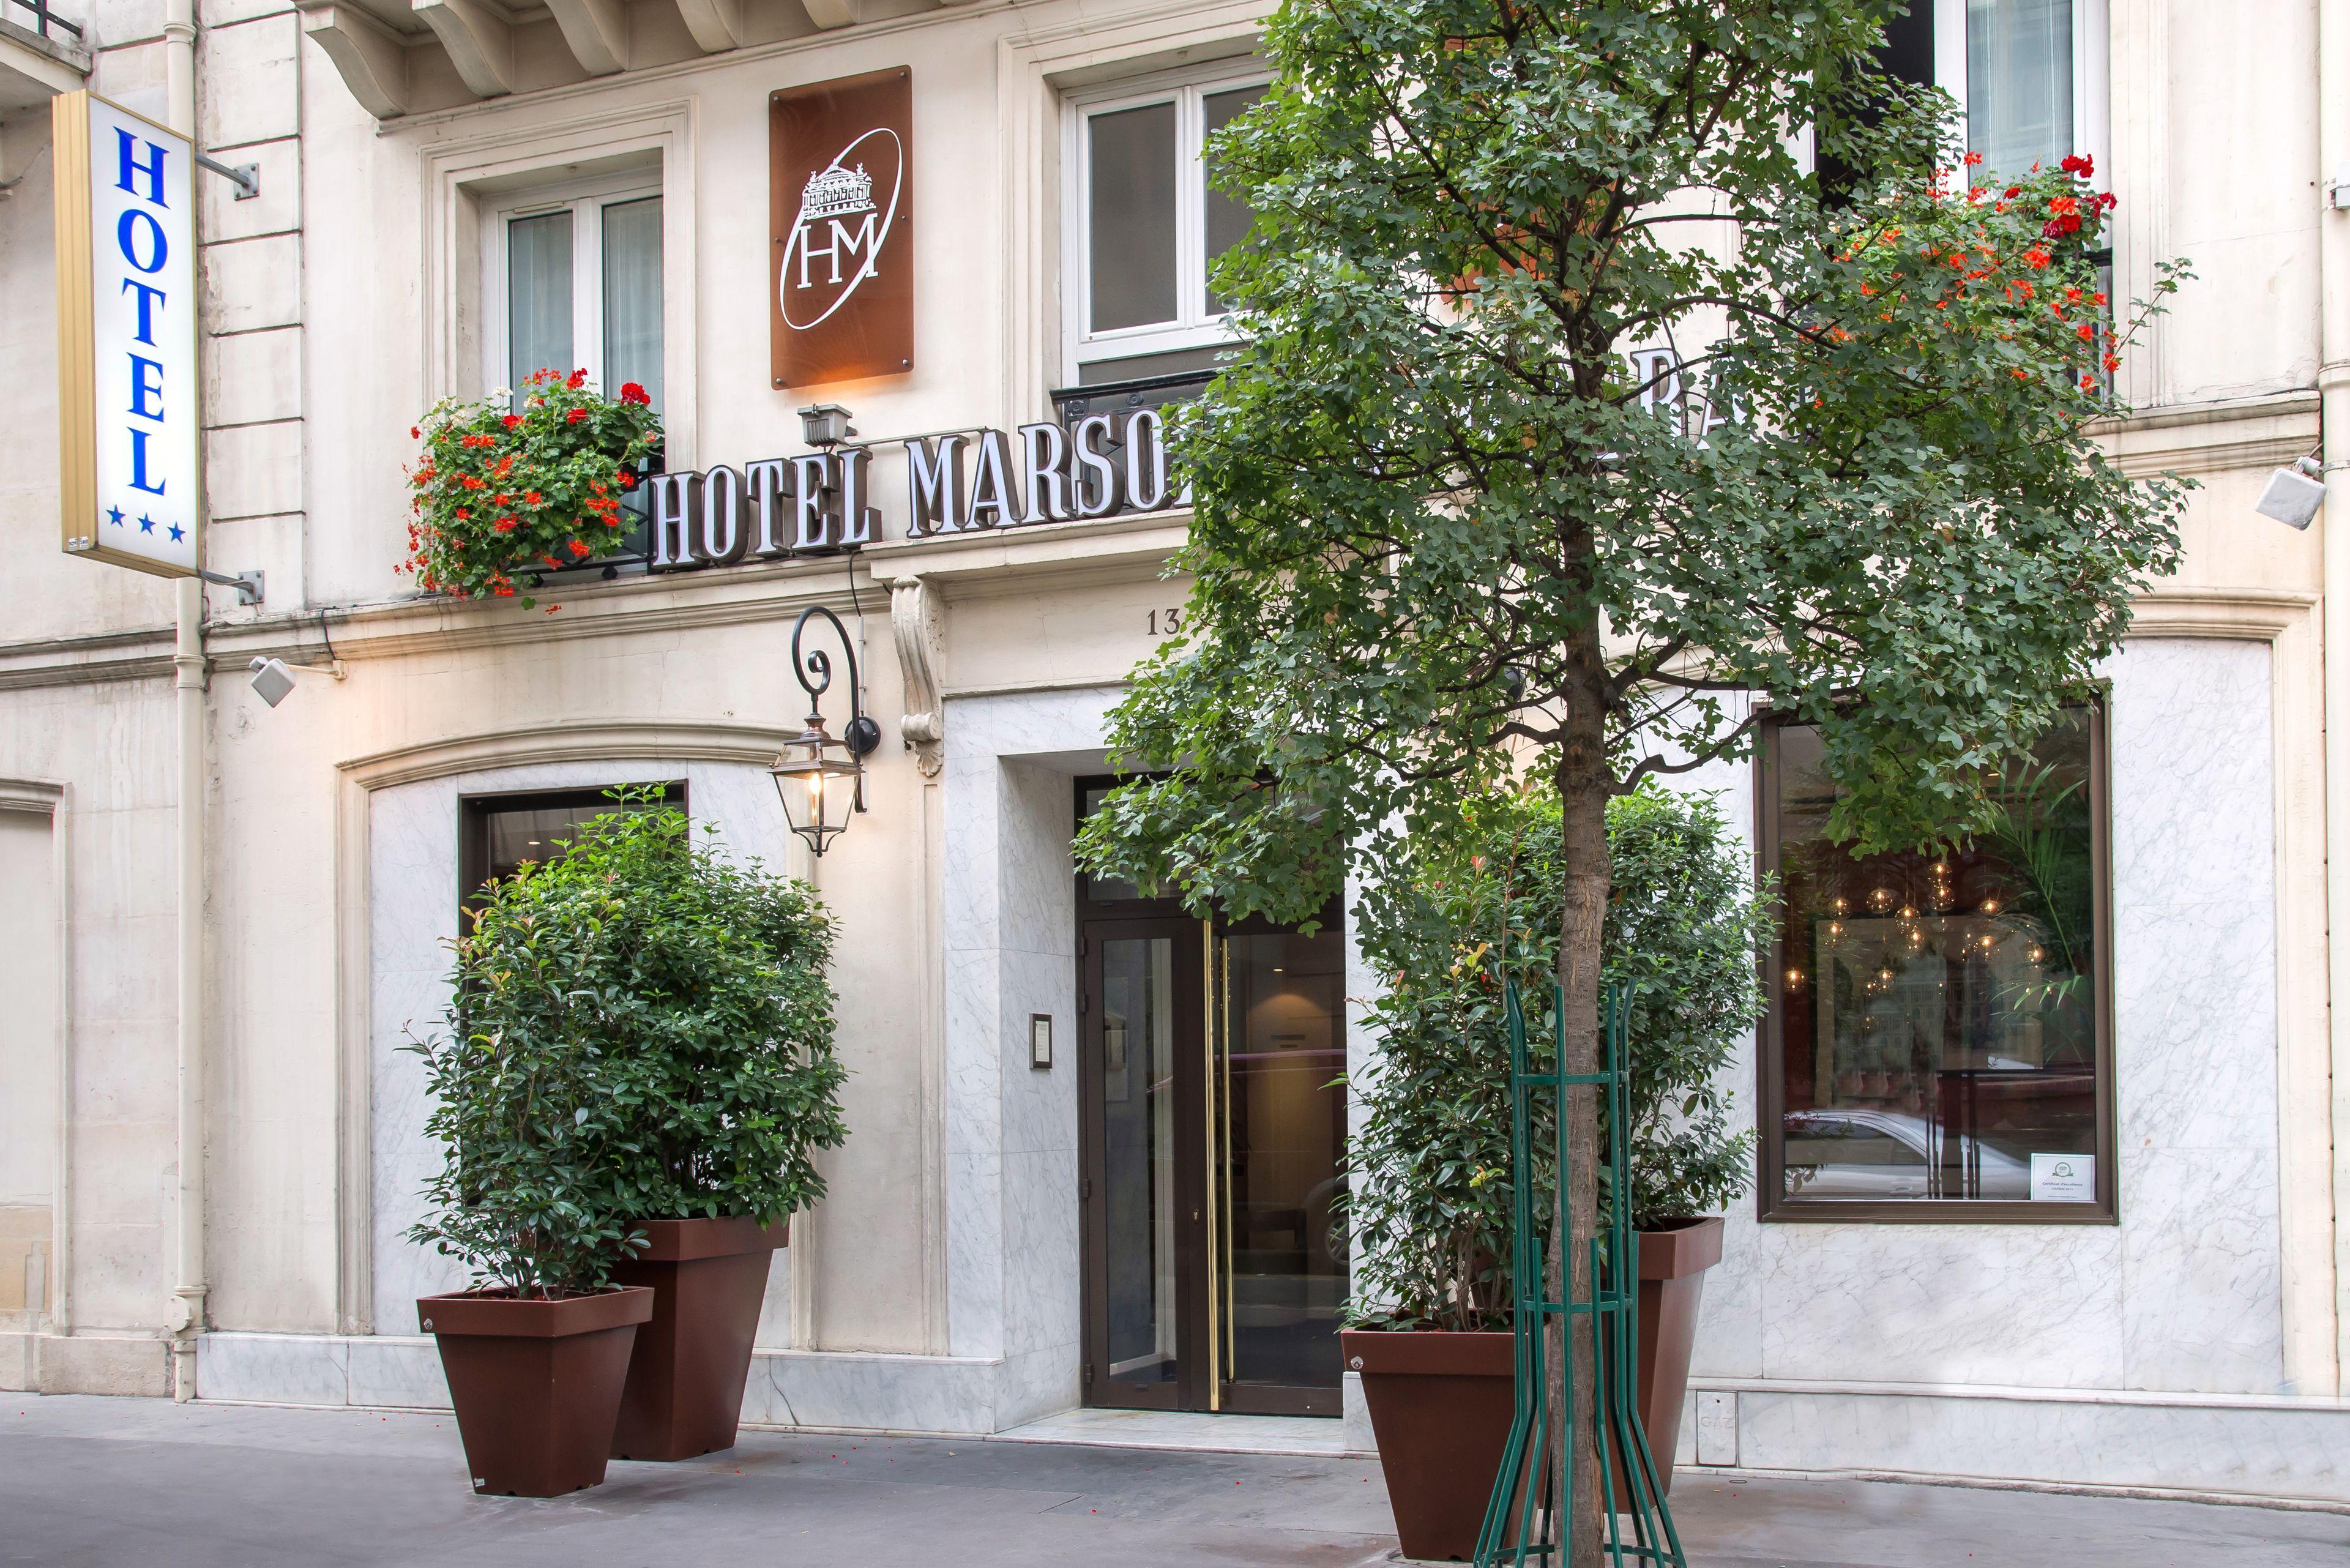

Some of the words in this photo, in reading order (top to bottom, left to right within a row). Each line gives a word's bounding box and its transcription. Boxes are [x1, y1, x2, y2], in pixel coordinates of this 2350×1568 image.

[797, 212, 879, 289] HM
[113, 125, 171, 496] HOTEL
[649, 447, 879, 568] HOTEL
[1147, 608, 1181, 636] 13
